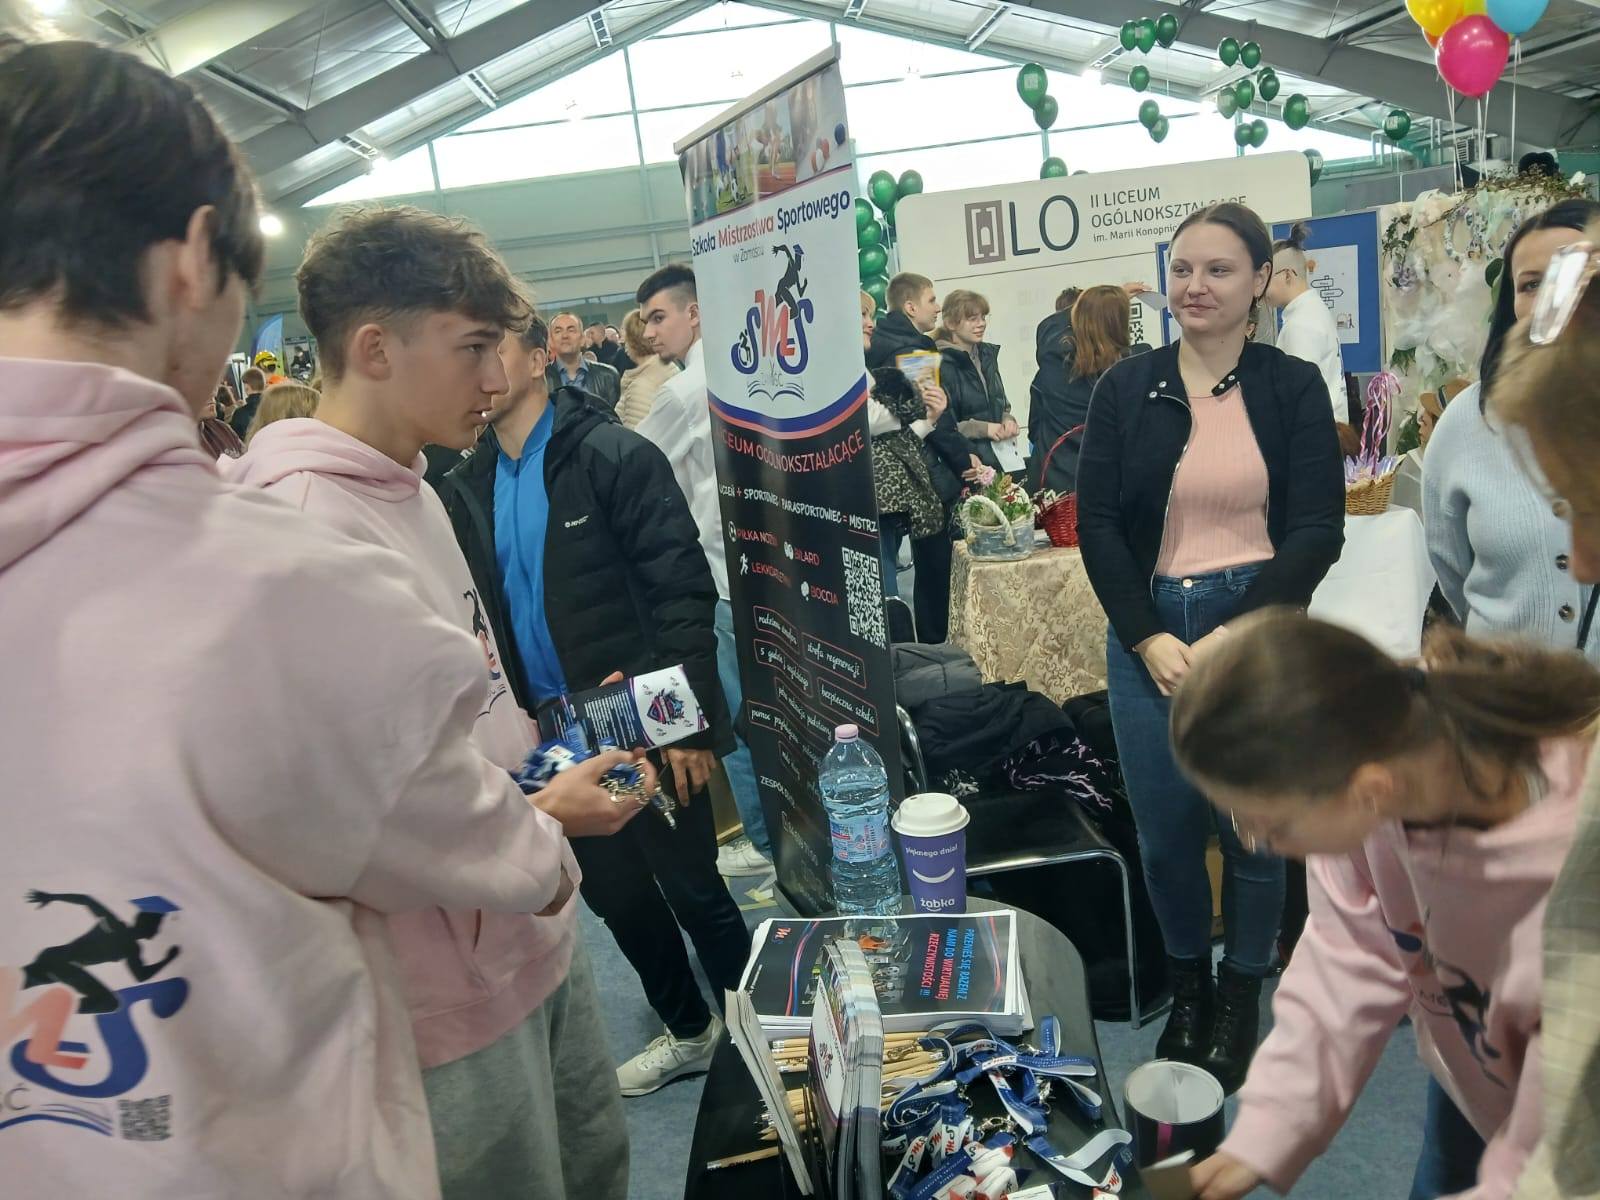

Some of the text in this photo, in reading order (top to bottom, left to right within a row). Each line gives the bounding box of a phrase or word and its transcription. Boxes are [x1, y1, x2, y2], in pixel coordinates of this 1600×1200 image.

[1091, 187, 1160, 208] II LICEUM
[1091, 196, 1247, 228] OGÓLNOKSZTAE
[692, 190, 850, 257] Szkoła Mistrzostwa Sportowego
[1093, 224, 1179, 243] im. Marii Konopnic
[849, 515, 878, 532] MISTRZ
[810, 585, 839, 605] BOCCIA
[920, 898, 955, 908] żabka
[921, 933, 940, 988] RZECZYWISTOŚCI
[935, 928, 958, 1000] NAMI DO WIRTUALNEJ
[957, 970, 970, 994] RAZEM
